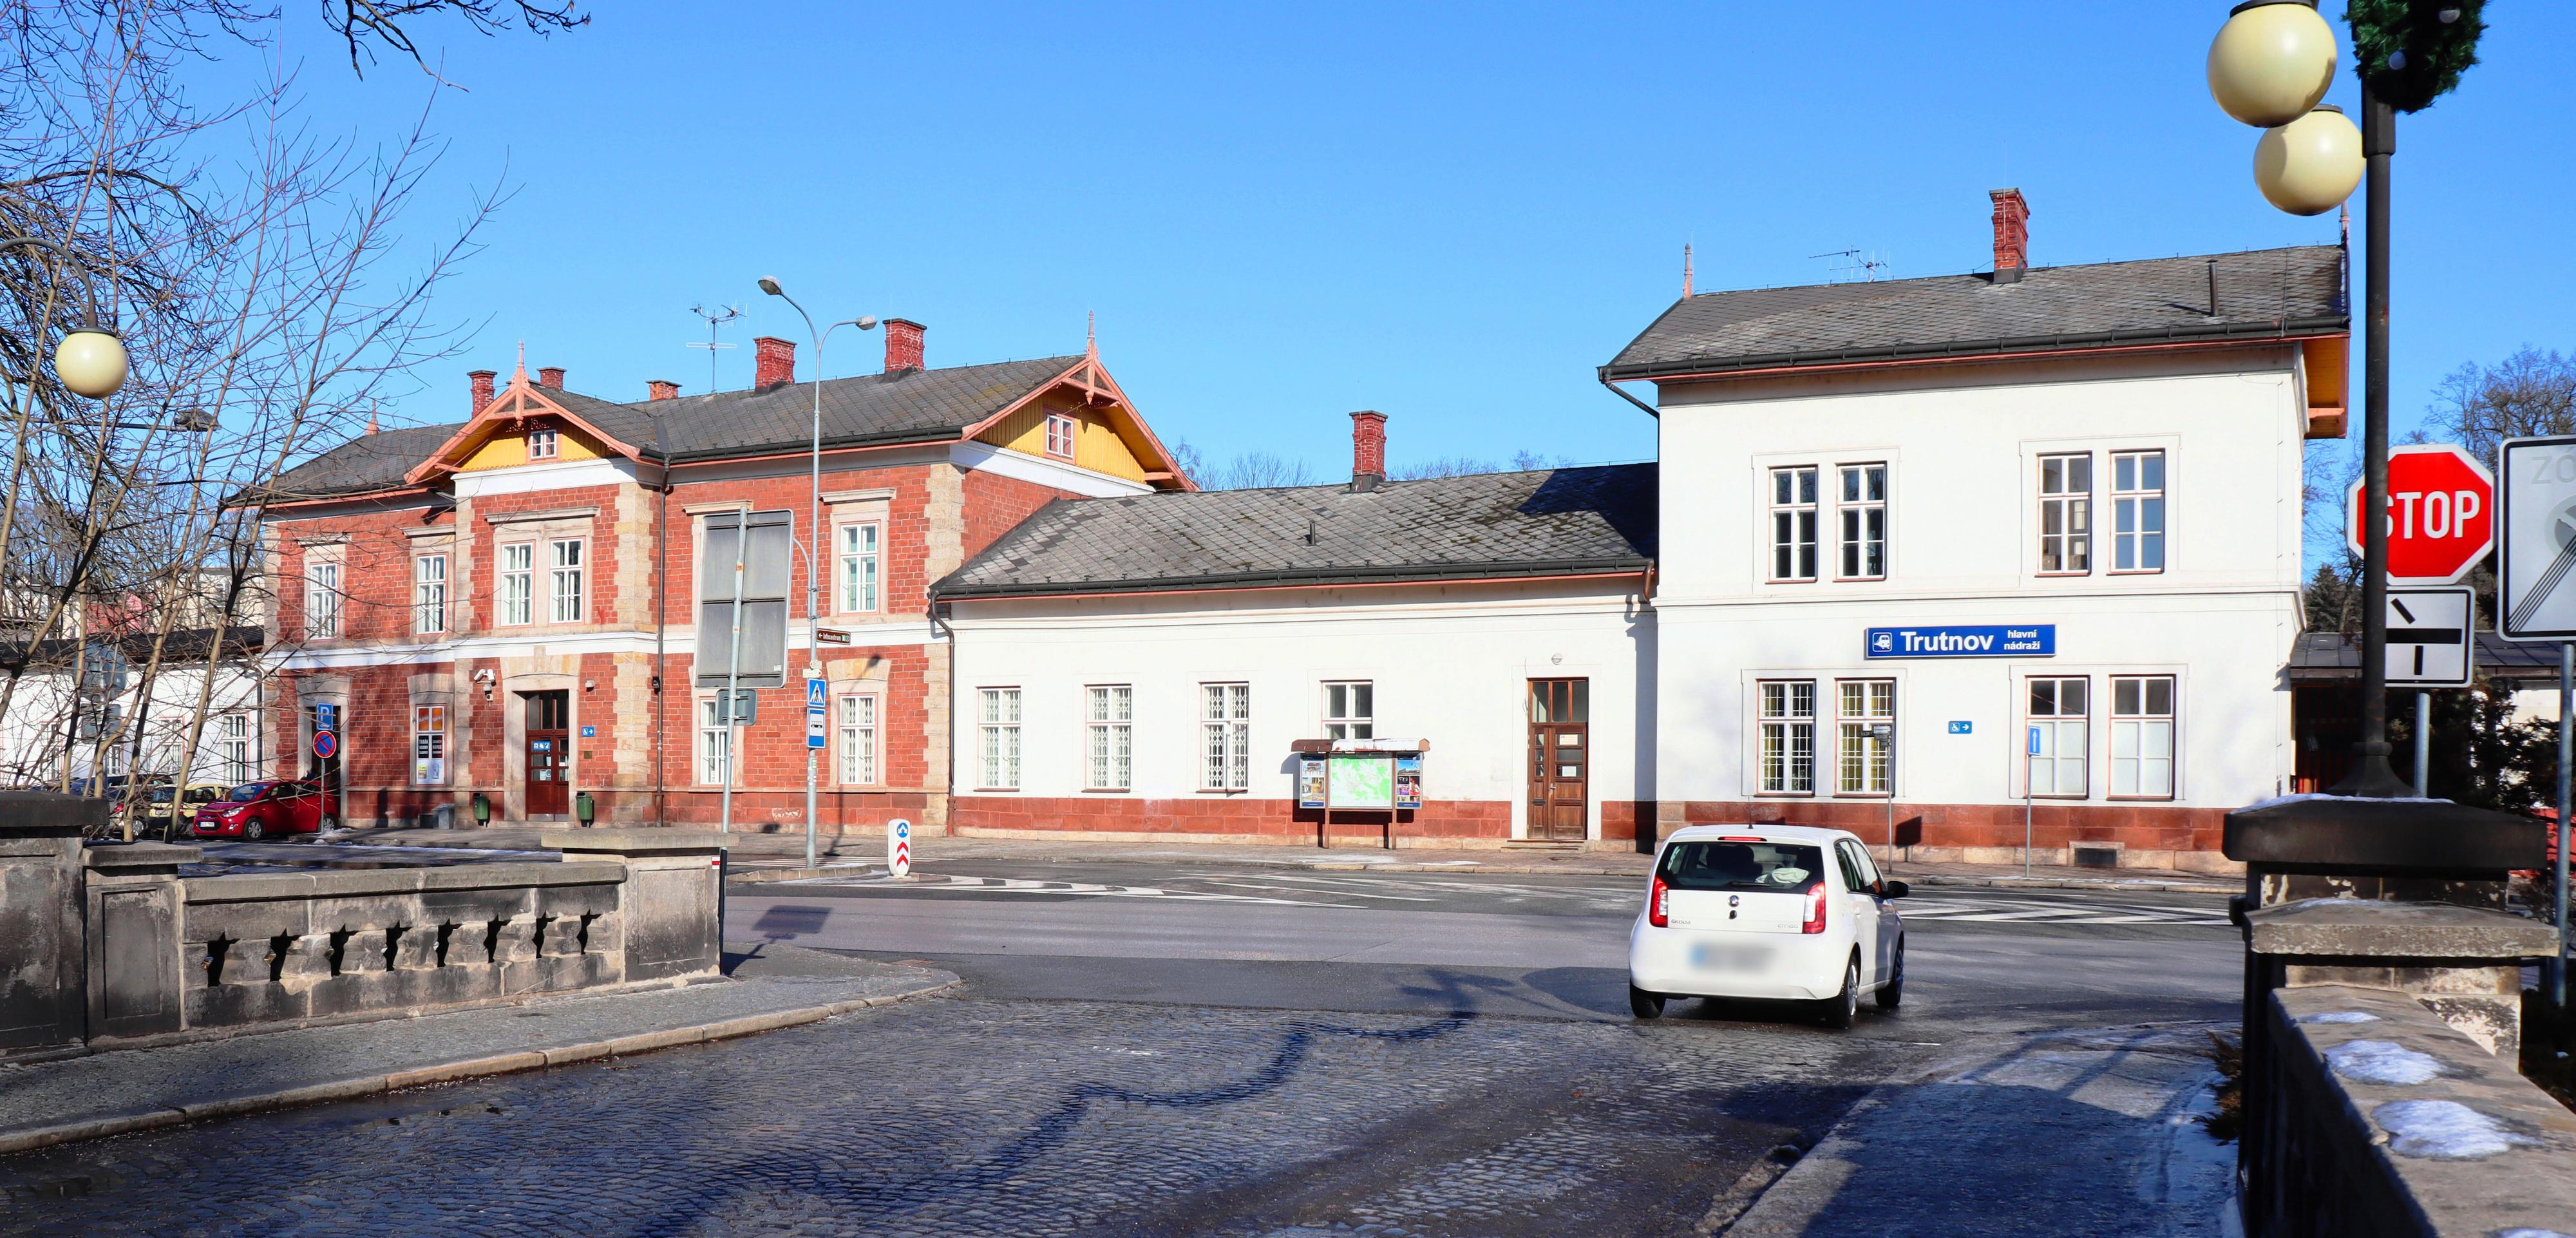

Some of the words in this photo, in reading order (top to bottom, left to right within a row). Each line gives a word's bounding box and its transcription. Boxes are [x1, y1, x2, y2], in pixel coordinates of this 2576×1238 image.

[2387, 490, 2480, 539] TOP
[823, 633, 841, 641] Infocentrum
[2007, 629, 2037, 638] hlavní
[1900, 631, 1994, 652] Trutnov
[2003, 641, 2040, 650] nádraží
[321, 707, 329, 721] P
